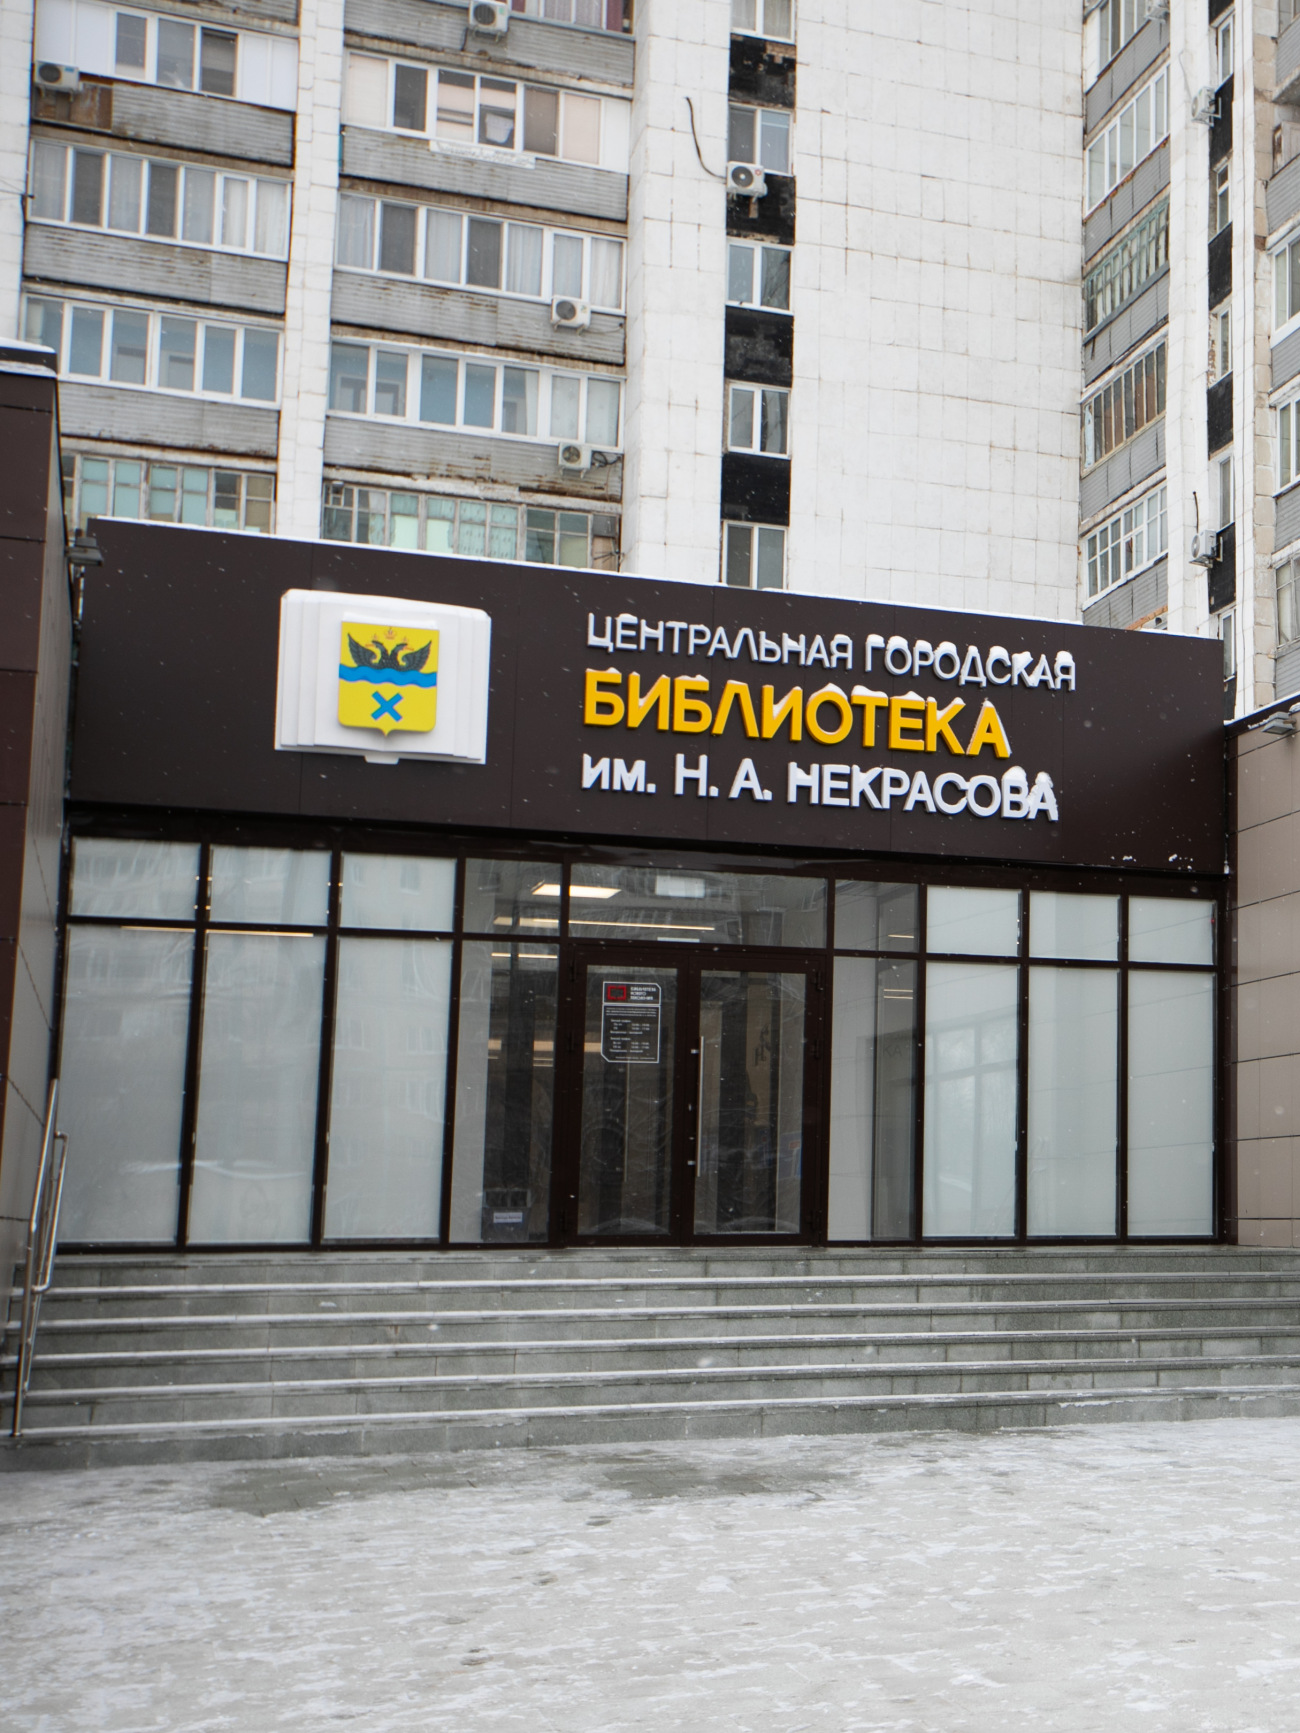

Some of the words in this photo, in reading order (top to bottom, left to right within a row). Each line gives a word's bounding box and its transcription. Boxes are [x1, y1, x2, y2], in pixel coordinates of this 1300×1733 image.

[586, 612, 853, 670] ЦЕНТРАЛЬНАЯ
[865, 633, 1077, 691] ГОРОДСКАЯ
[583, 667, 1012, 758] БИБЛИОТЕКА
[674, 753, 719, 797] Н.
[728, 757, 772, 801] А.
[787, 764, 1059, 822] НЕКРАСОВА
